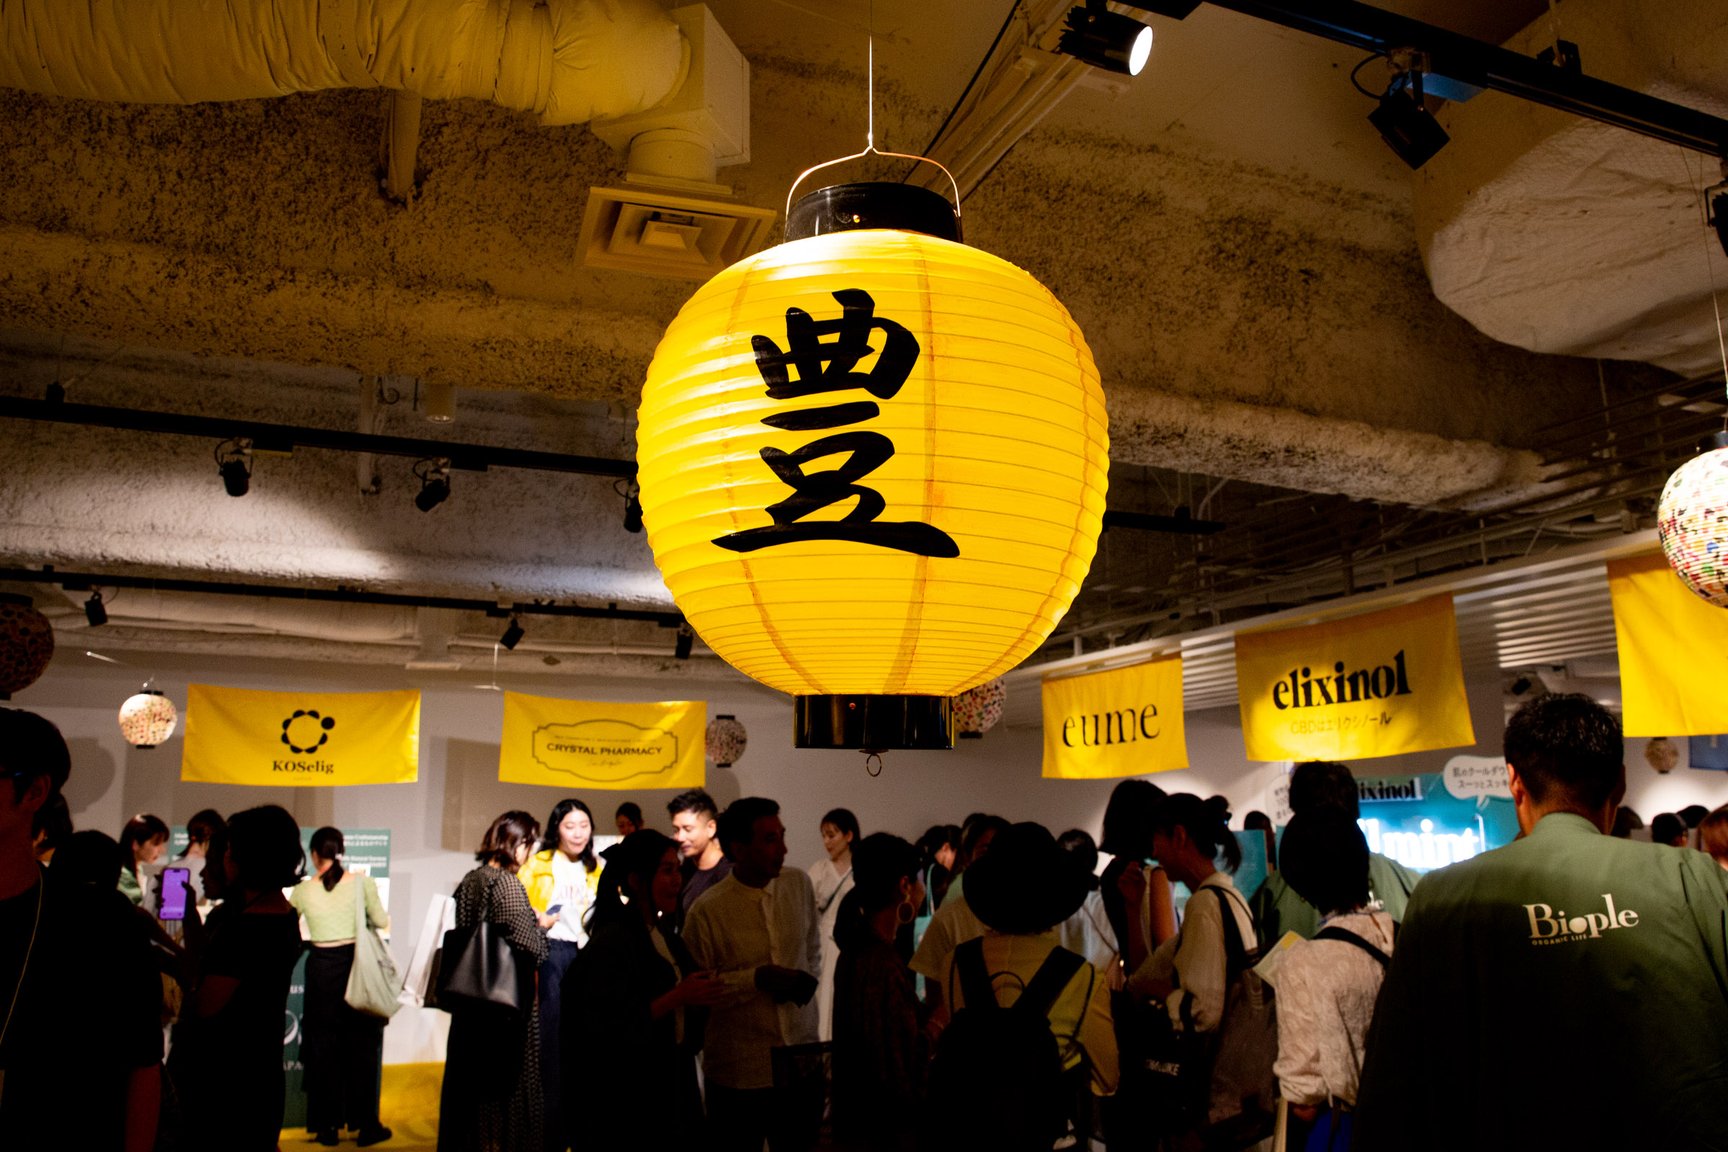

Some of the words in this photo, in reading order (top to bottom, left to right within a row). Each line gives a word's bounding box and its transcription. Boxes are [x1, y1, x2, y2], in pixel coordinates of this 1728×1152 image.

[711, 288, 960, 558] 豊
[1273, 649, 1413, 711] elixinol
[1062, 704, 1160, 748] eume
[547, 742, 597, 756] CRYSTAL
[600, 746, 662, 756] PHARMACY
[273, 760, 334, 774] KOSelig
[1359, 778, 1417, 801] ixinol
[1522, 893, 1639, 938] Biople
[1532, 936, 1568, 946] ORGANIC
[1571, 934, 1587, 942] LIFE
